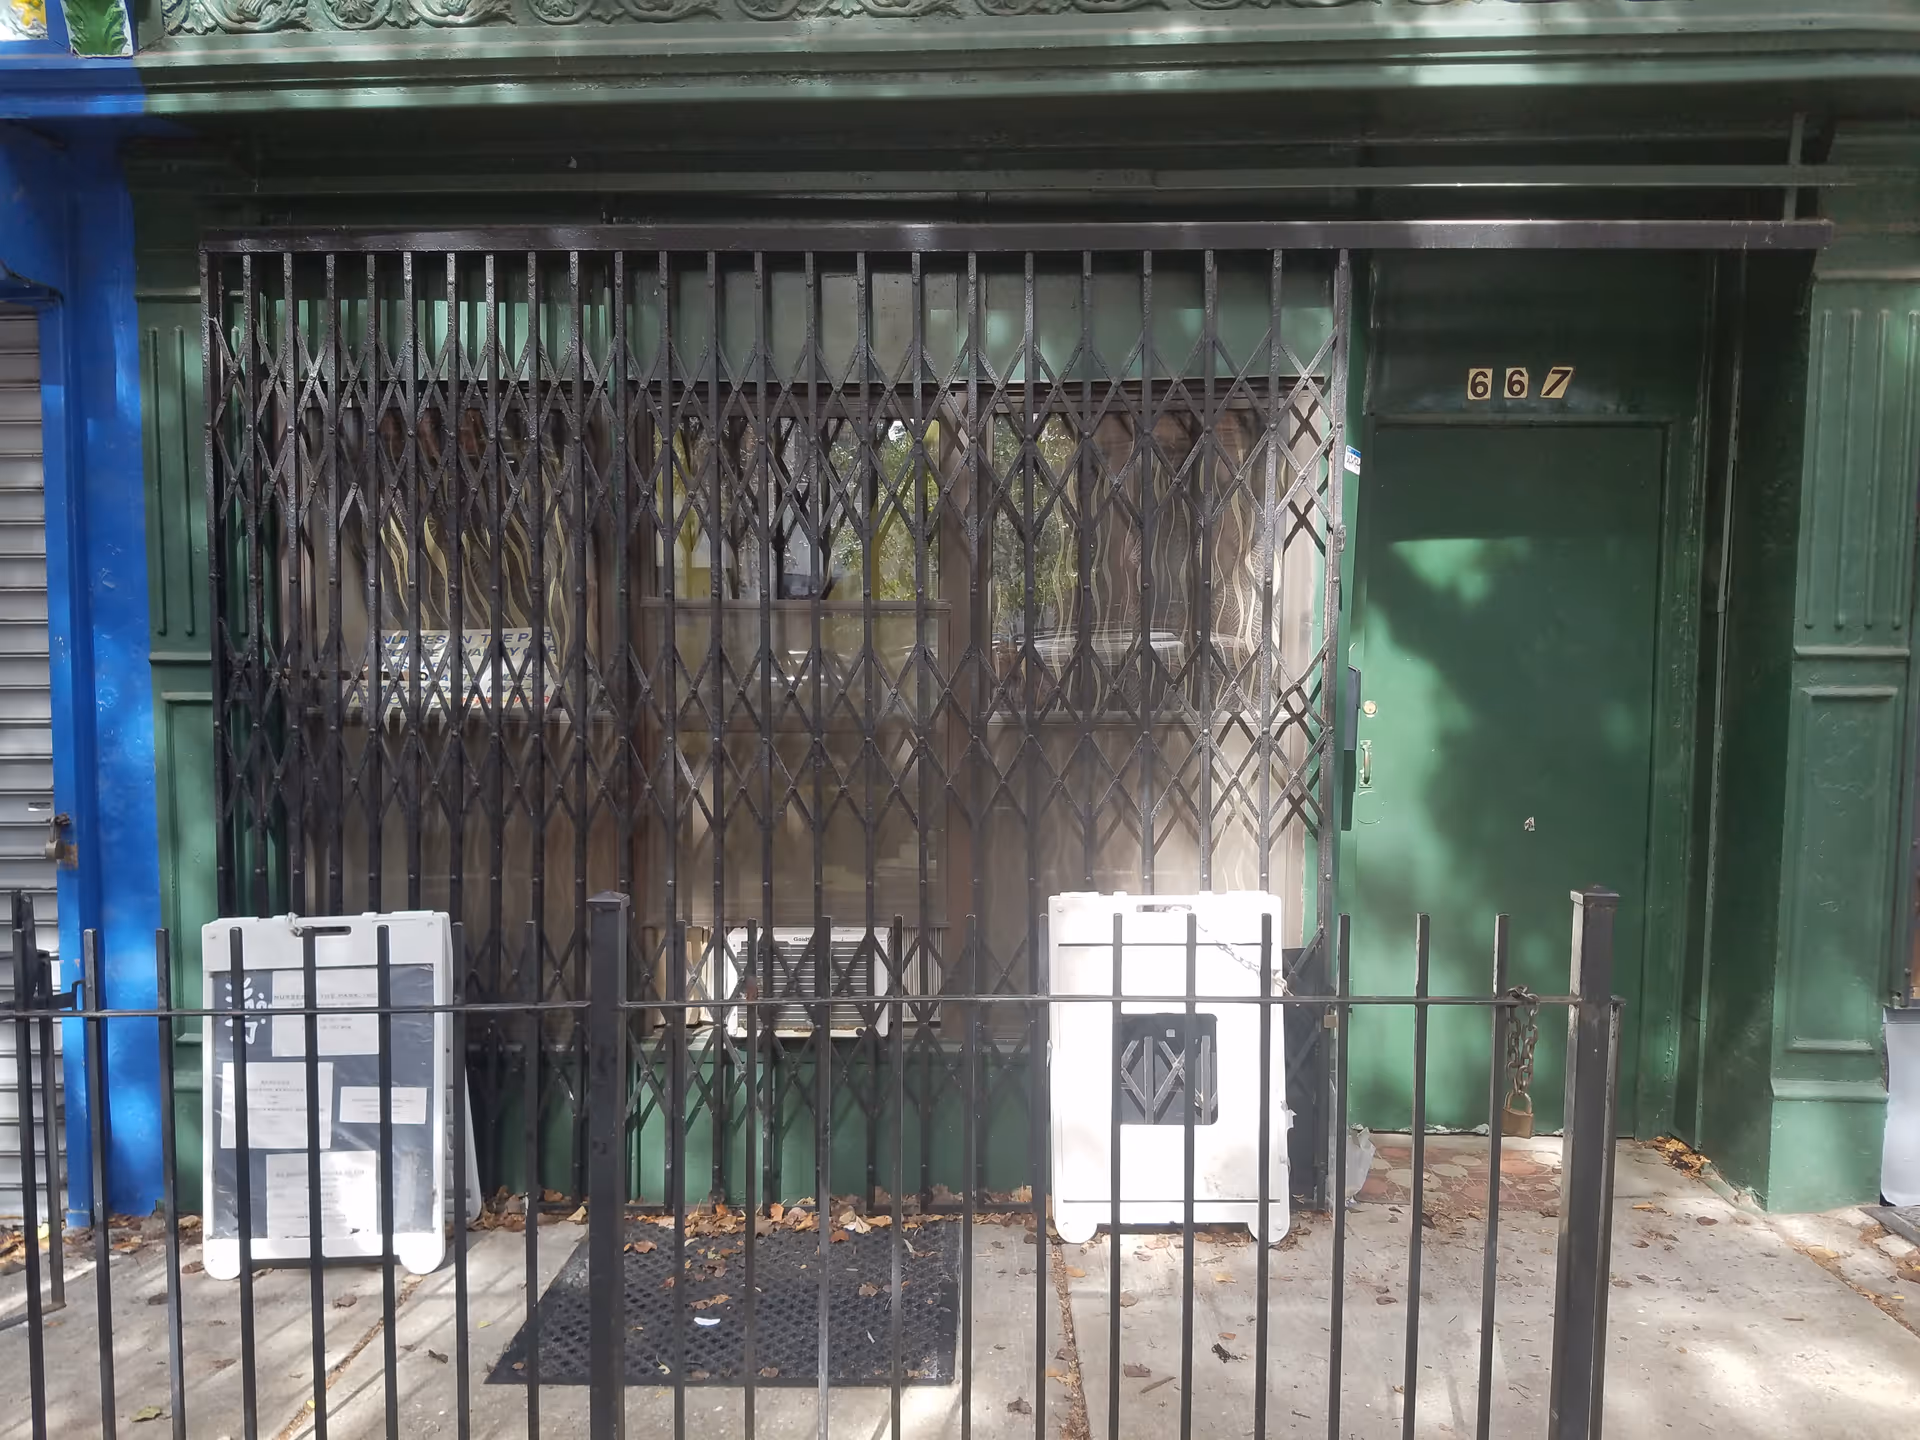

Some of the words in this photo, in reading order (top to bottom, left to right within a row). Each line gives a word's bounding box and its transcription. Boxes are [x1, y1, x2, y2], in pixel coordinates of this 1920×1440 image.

[1469, 367, 1573, 398] 667
[382, 635, 446, 644] NUES
[481, 633, 514, 643] TE
